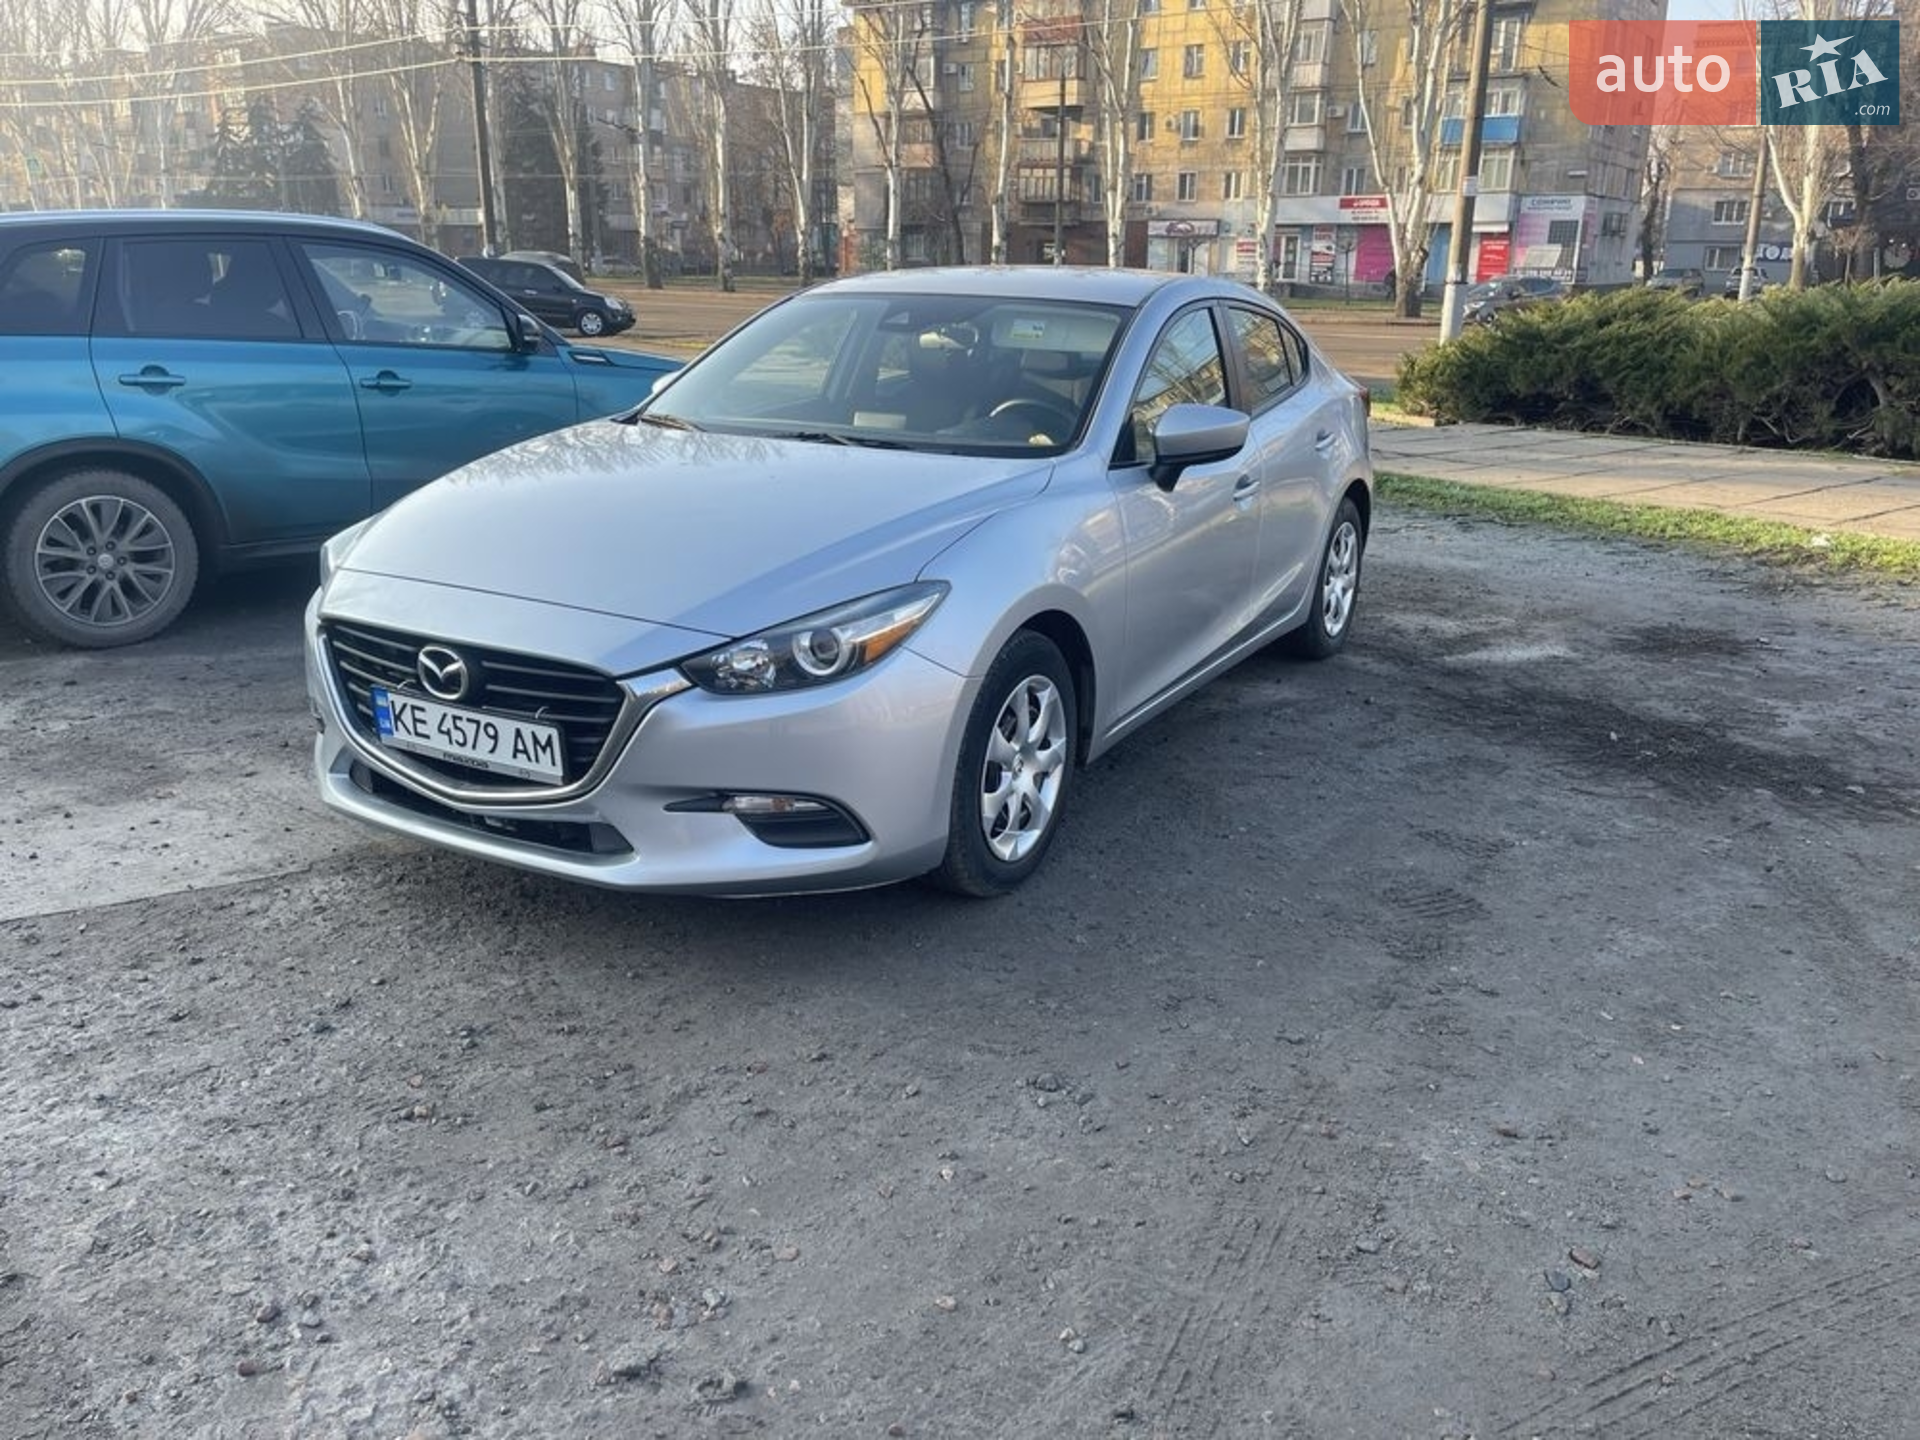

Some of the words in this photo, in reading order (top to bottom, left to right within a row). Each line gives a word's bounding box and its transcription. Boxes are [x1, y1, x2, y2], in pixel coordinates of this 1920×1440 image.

[390, 699, 431, 740] KE
[437, 711, 499, 754] 4579
[512, 727, 557, 767] AM
